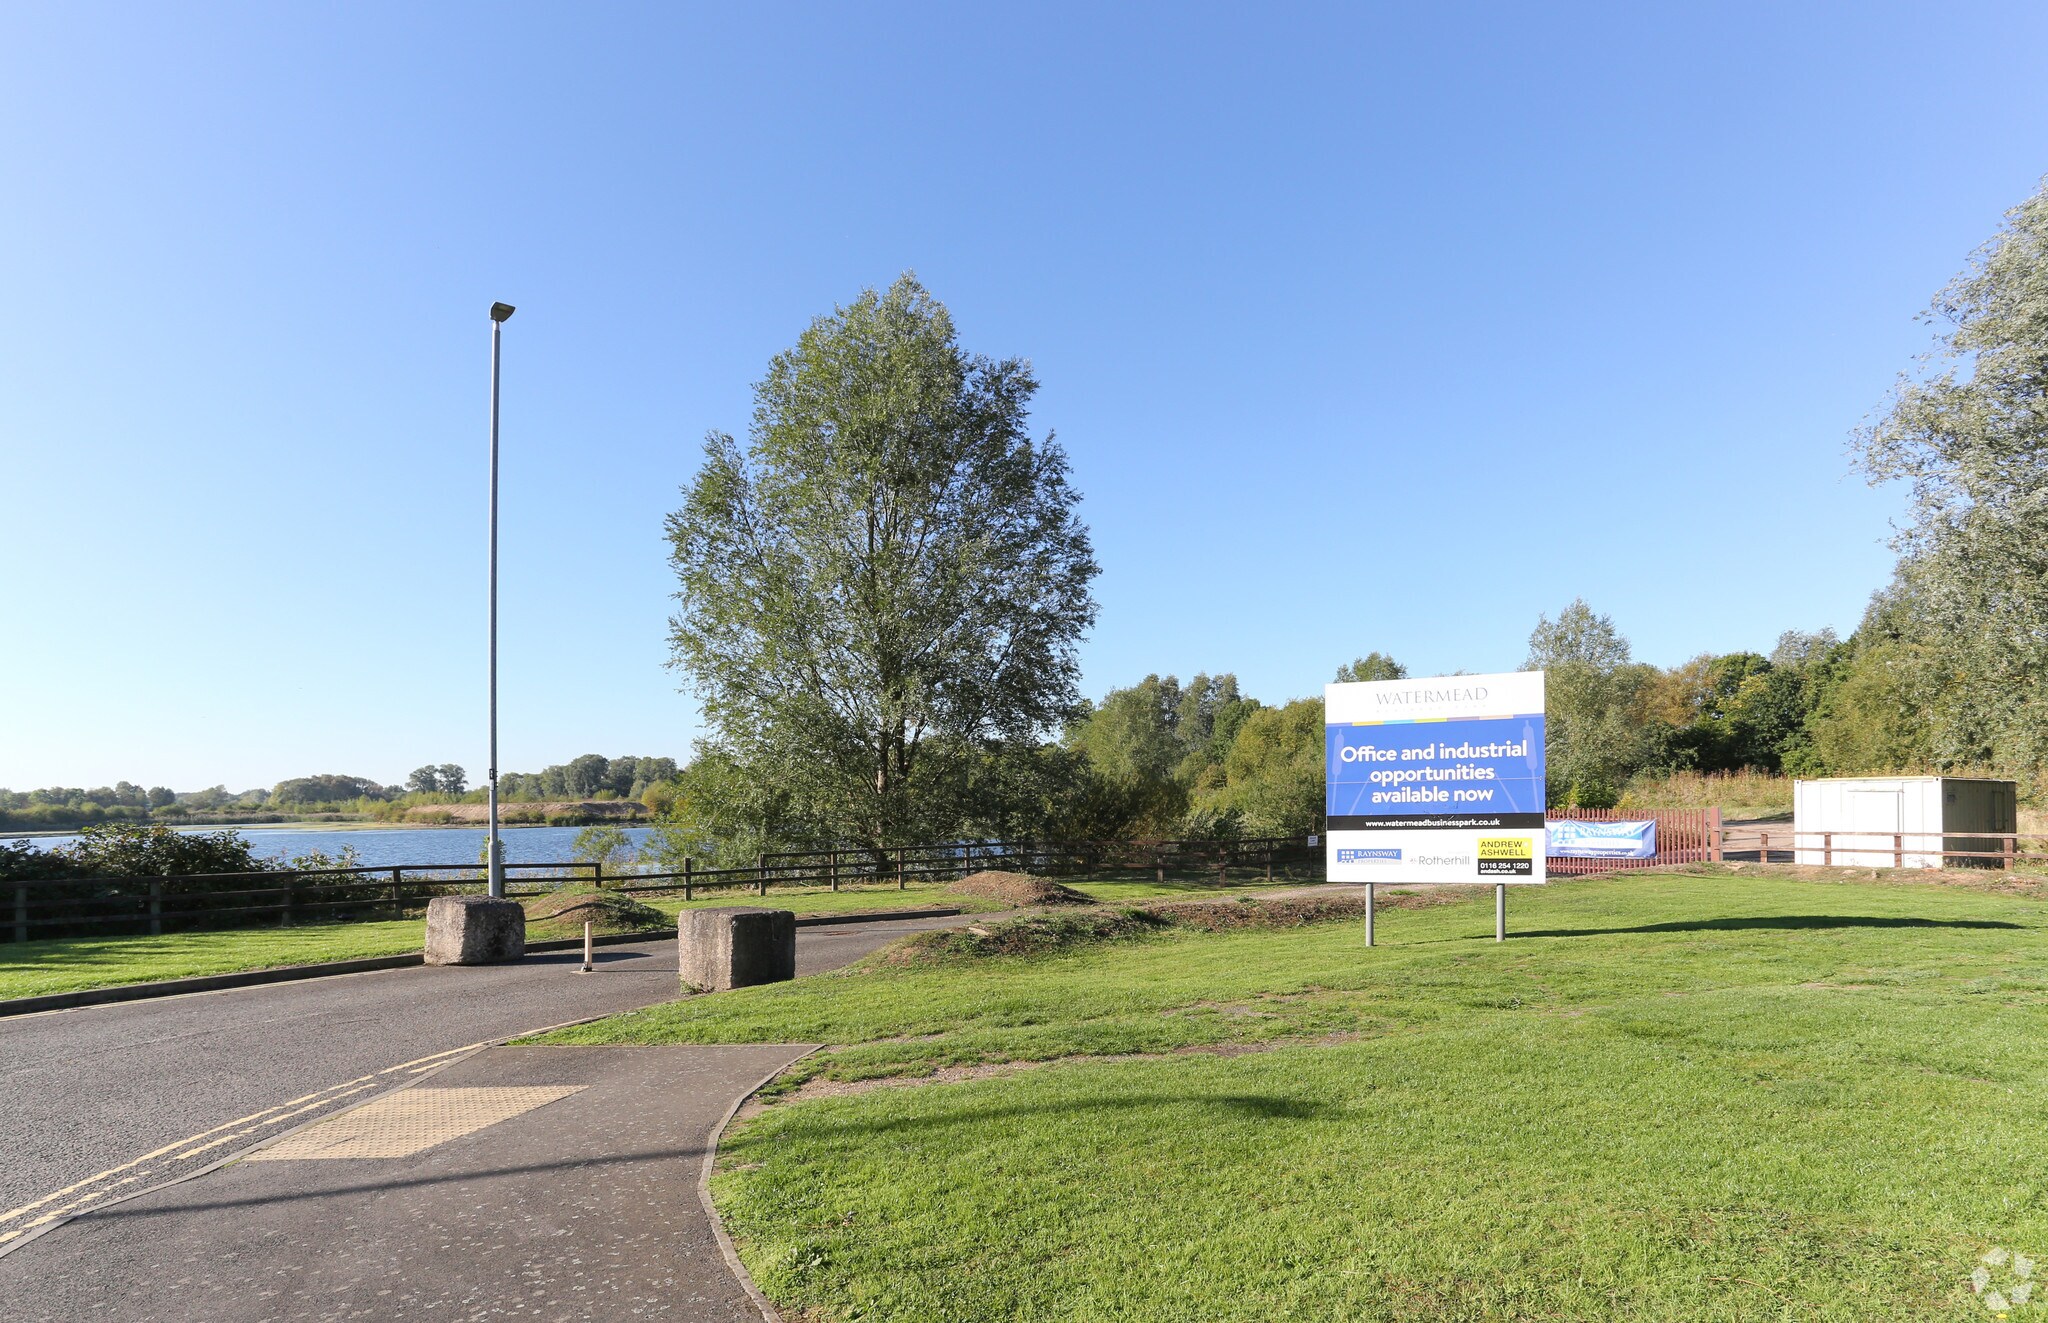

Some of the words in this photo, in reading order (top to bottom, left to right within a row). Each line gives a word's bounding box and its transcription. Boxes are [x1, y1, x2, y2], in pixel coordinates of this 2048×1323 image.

[1376, 687, 1488, 705] WATERMEAD
[1340, 745, 1397, 763] Office
[1401, 743, 1435, 761] and
[1439, 739, 1527, 759] industrial
[1370, 763, 1495, 787] opportunities
[1371, 786, 1449, 804] available
[1453, 788, 1493, 802] now
[1365, 818, 1500, 828] www.watermeadbusinesspark.co.uk
[1480, 840, 1523, 848] ANDREW
[1418, 855, 1470, 866] Rotherhill
